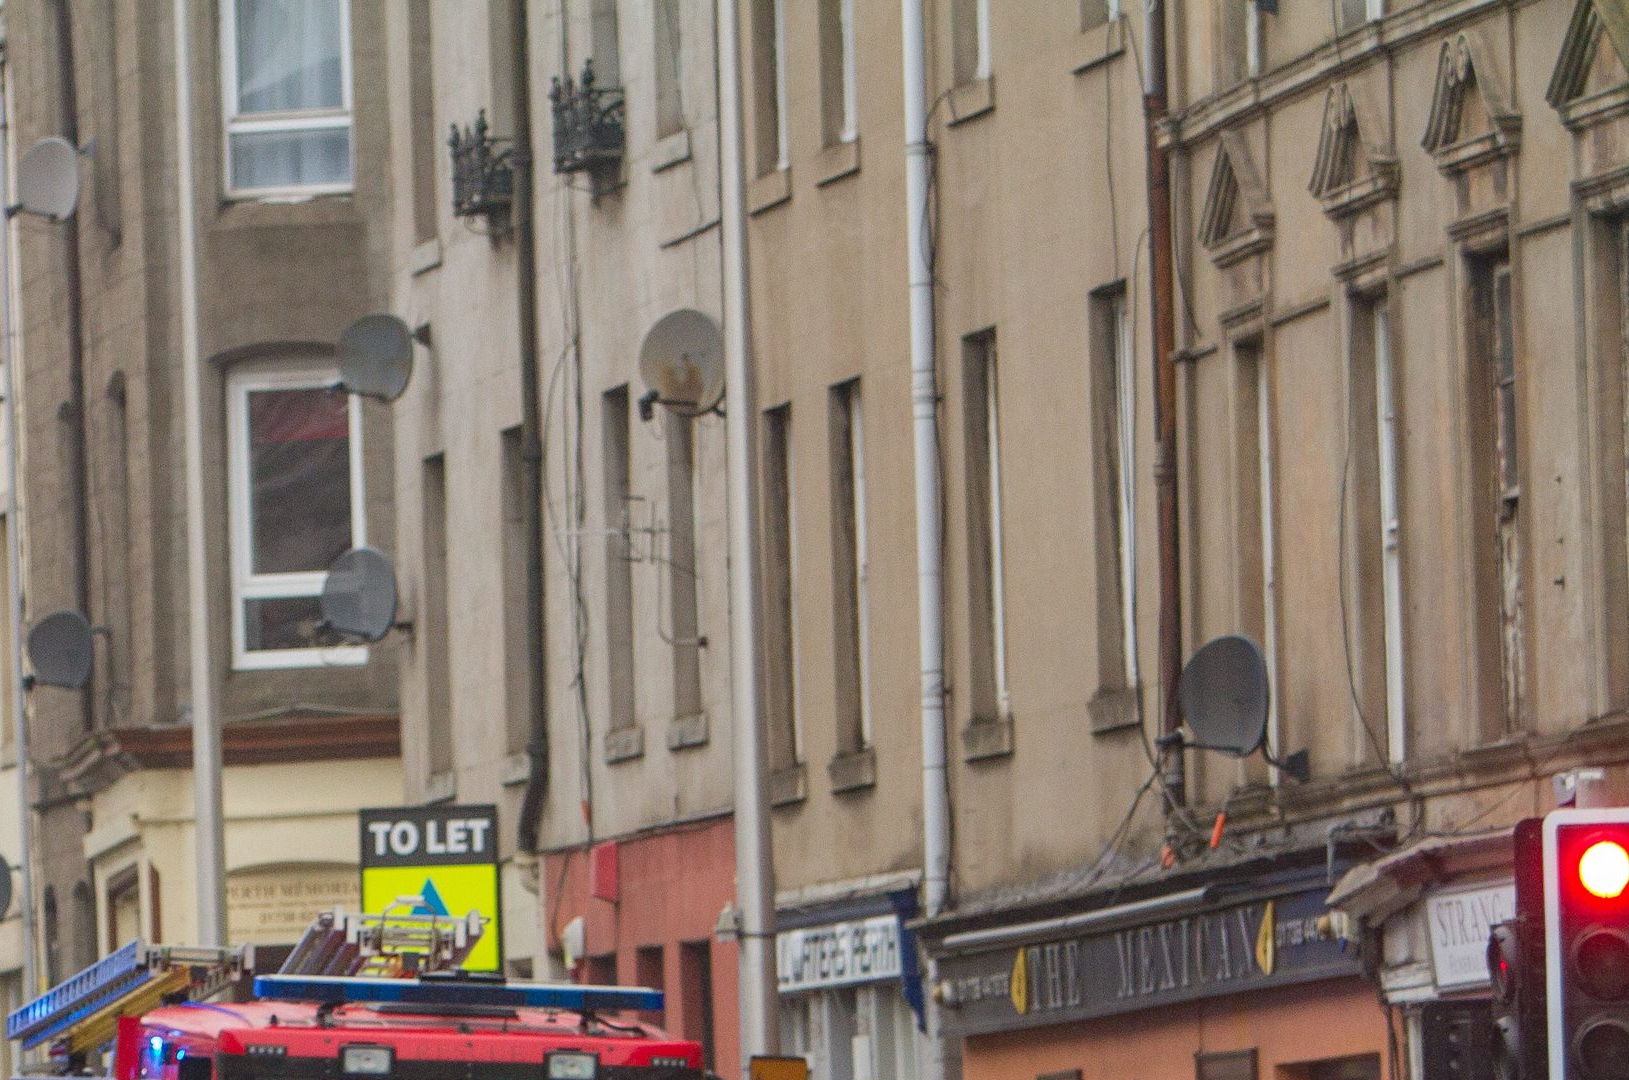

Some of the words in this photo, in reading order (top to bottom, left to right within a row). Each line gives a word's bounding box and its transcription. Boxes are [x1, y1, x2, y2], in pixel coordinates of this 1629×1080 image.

[369, 819, 420, 855] TO
[426, 818, 490, 854] LET
[1028, 941, 1080, 1010] THE
[1115, 905, 1253, 998] MEXICAN
